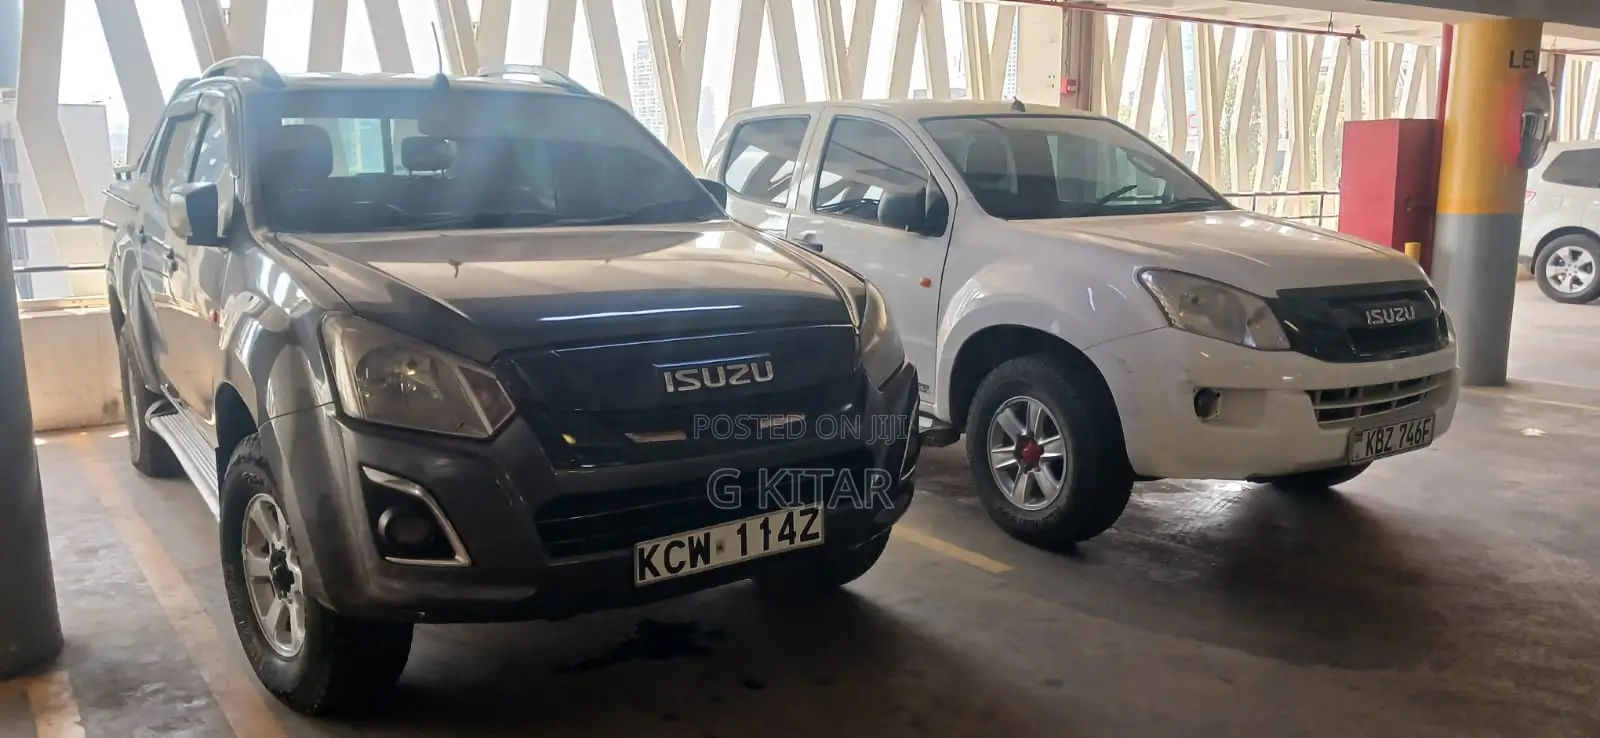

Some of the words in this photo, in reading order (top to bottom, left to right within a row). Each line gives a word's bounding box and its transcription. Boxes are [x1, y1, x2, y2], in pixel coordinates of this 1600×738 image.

[1366, 305, 1416, 326] ISUZU
[663, 360, 774, 393] ISUZU
[1365, 427, 1395, 457] KBZ
[1399, 418, 1432, 448] 746F
[637, 531, 711, 581] KCW
[736, 507, 820, 557] 114Z
